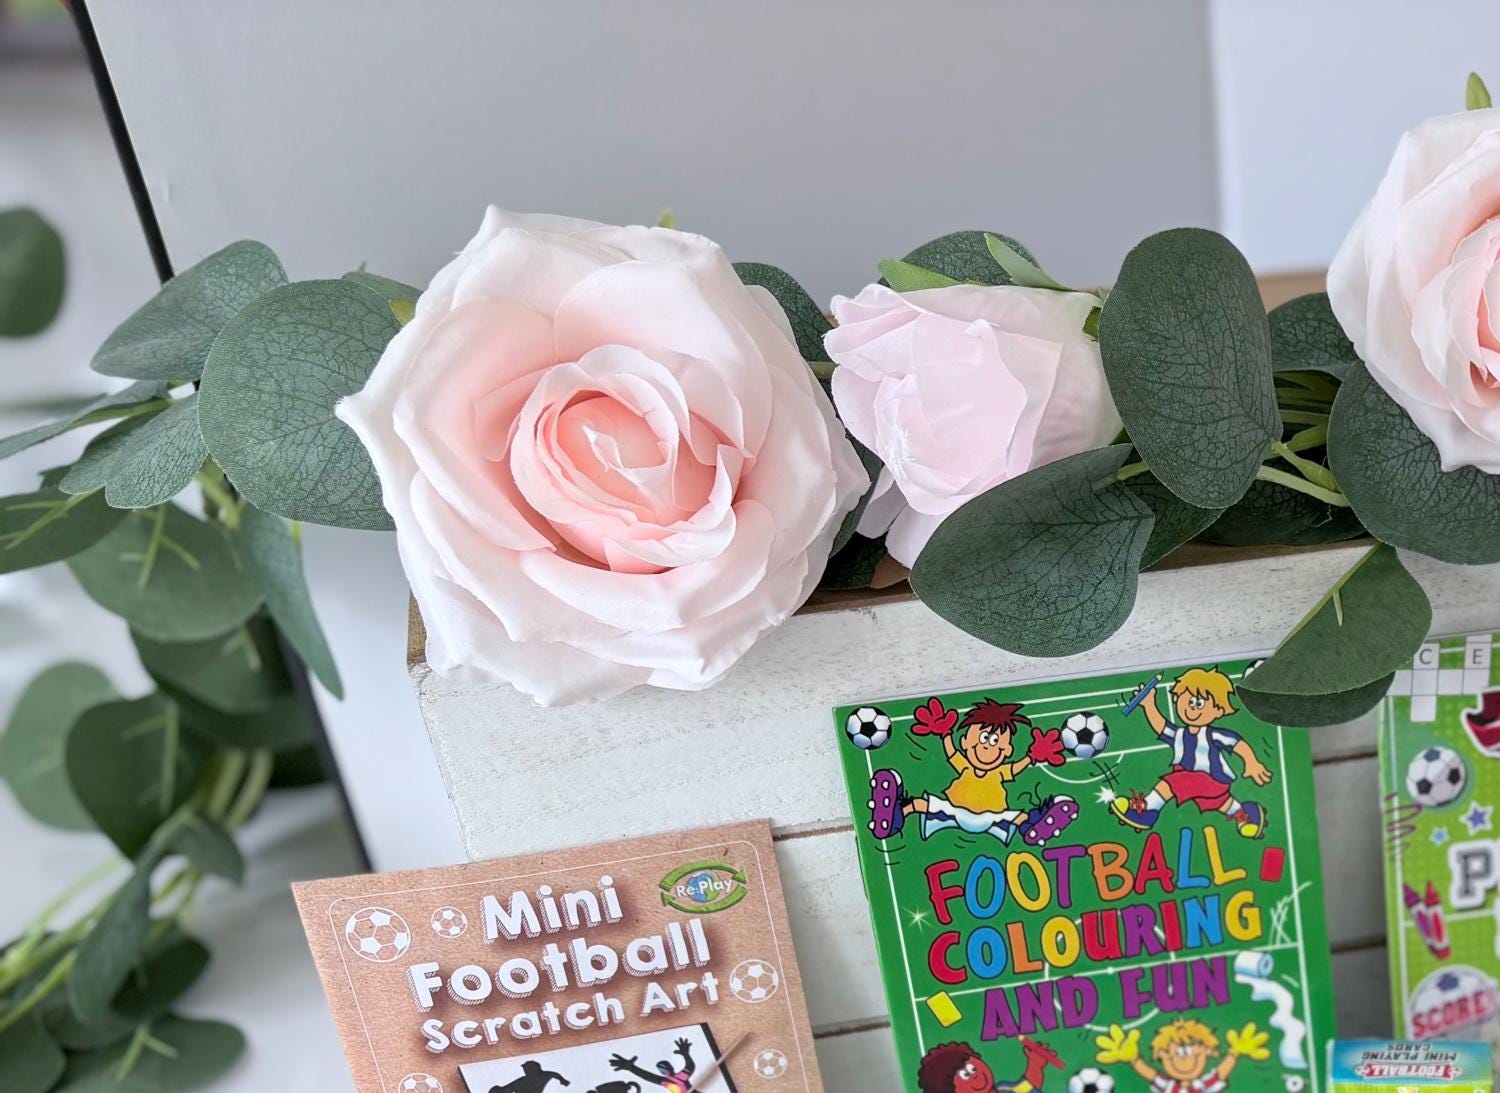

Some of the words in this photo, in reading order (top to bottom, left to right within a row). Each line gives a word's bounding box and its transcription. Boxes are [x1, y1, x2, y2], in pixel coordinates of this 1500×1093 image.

[480, 875, 623, 944] Mini
[925, 825, 1246, 925] FOOTBALL
[406, 918, 711, 1012] Football
[927, 889, 1262, 985] COLOURING
[420, 992, 624, 1053] Scratch
[640, 971, 720, 1017] Art
[980, 975, 1099, 1042] AND
[1120, 954, 1231, 1019] FUN
[1362, 1051, 1419, 1061] PLAYING
[1372, 1065, 1445, 1077] FOOTBALL
[1423, 1052, 1457, 1061] MINI
